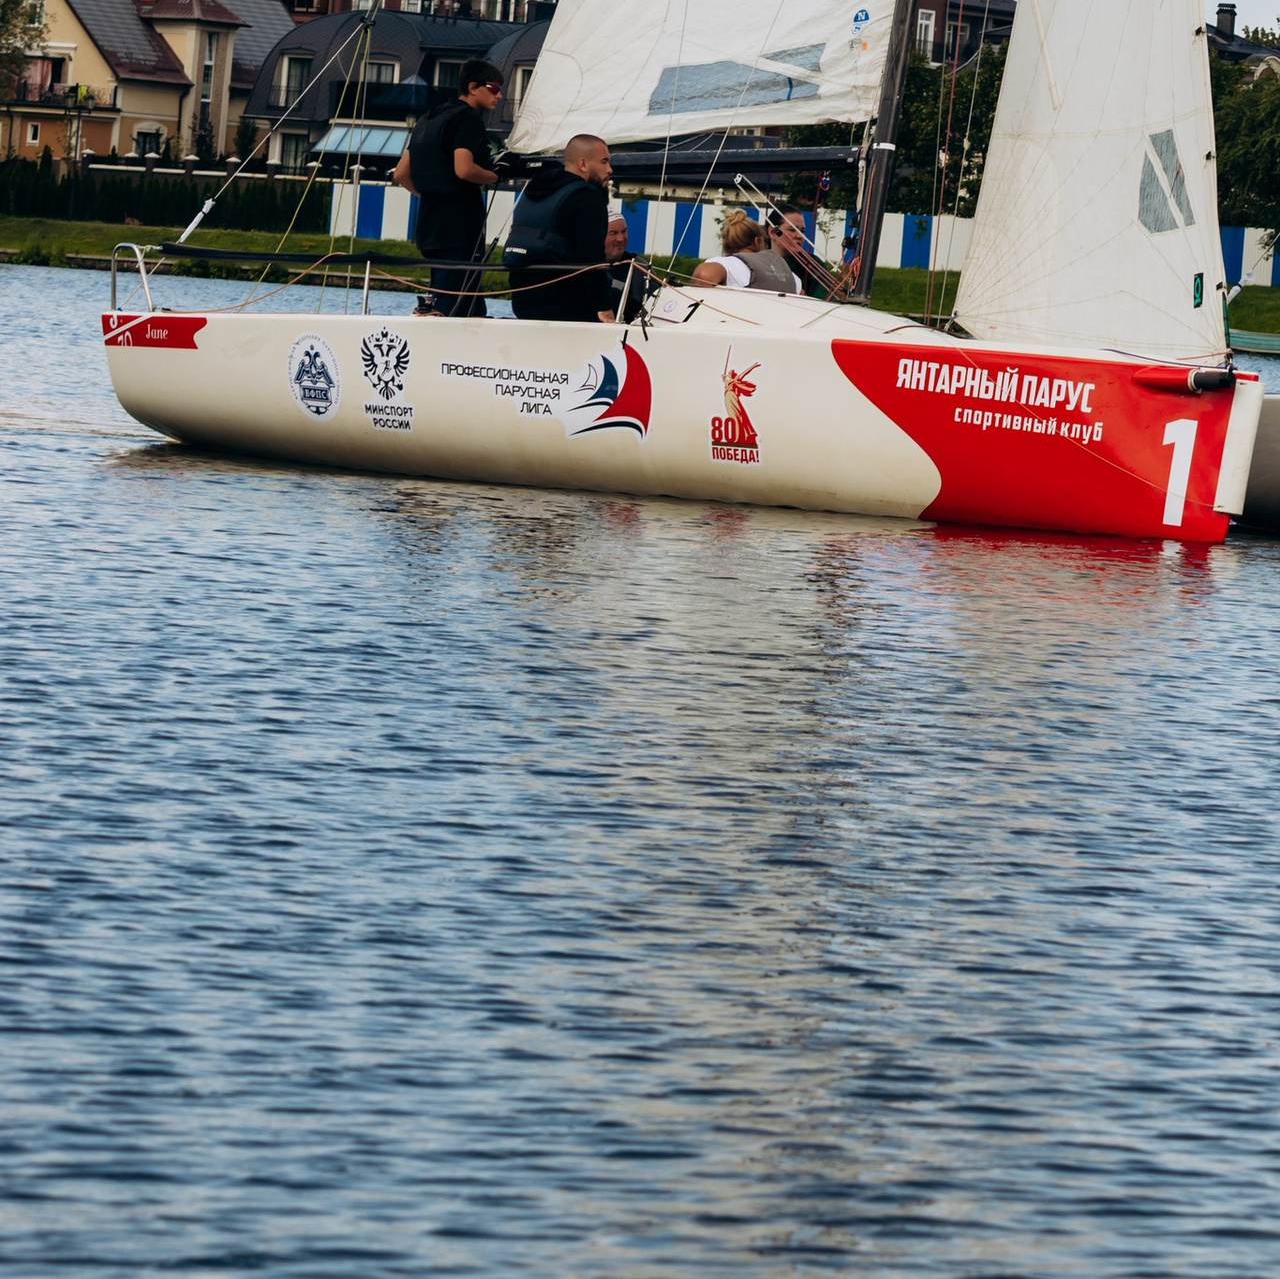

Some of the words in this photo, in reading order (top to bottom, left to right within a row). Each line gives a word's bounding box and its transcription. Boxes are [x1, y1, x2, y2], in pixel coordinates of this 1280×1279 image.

[145, 324, 169, 339] Jane
[441, 363, 569, 385] ПРОФЕССИОНАЛЬНАЯ
[495, 384, 561, 400] ПАРУСНАЯ
[896, 358, 1019, 403] ЯНТАРНЫЙ
[1020, 374, 1095, 413] ПАРУС
[304, 389, 327, 400] ВФПС
[364, 404, 413, 417] МИНСПОРТ
[520, 402, 552, 415] ЛИГА
[373, 418, 411, 430] РОССИИ
[711, 416, 736, 443] 80
[954, 407, 1057, 436] спортивный
[1060, 422, 1103, 445] клуб
[712, 447, 759, 464] ПОБЕДА!
[1162, 418, 1198, 527] 1
